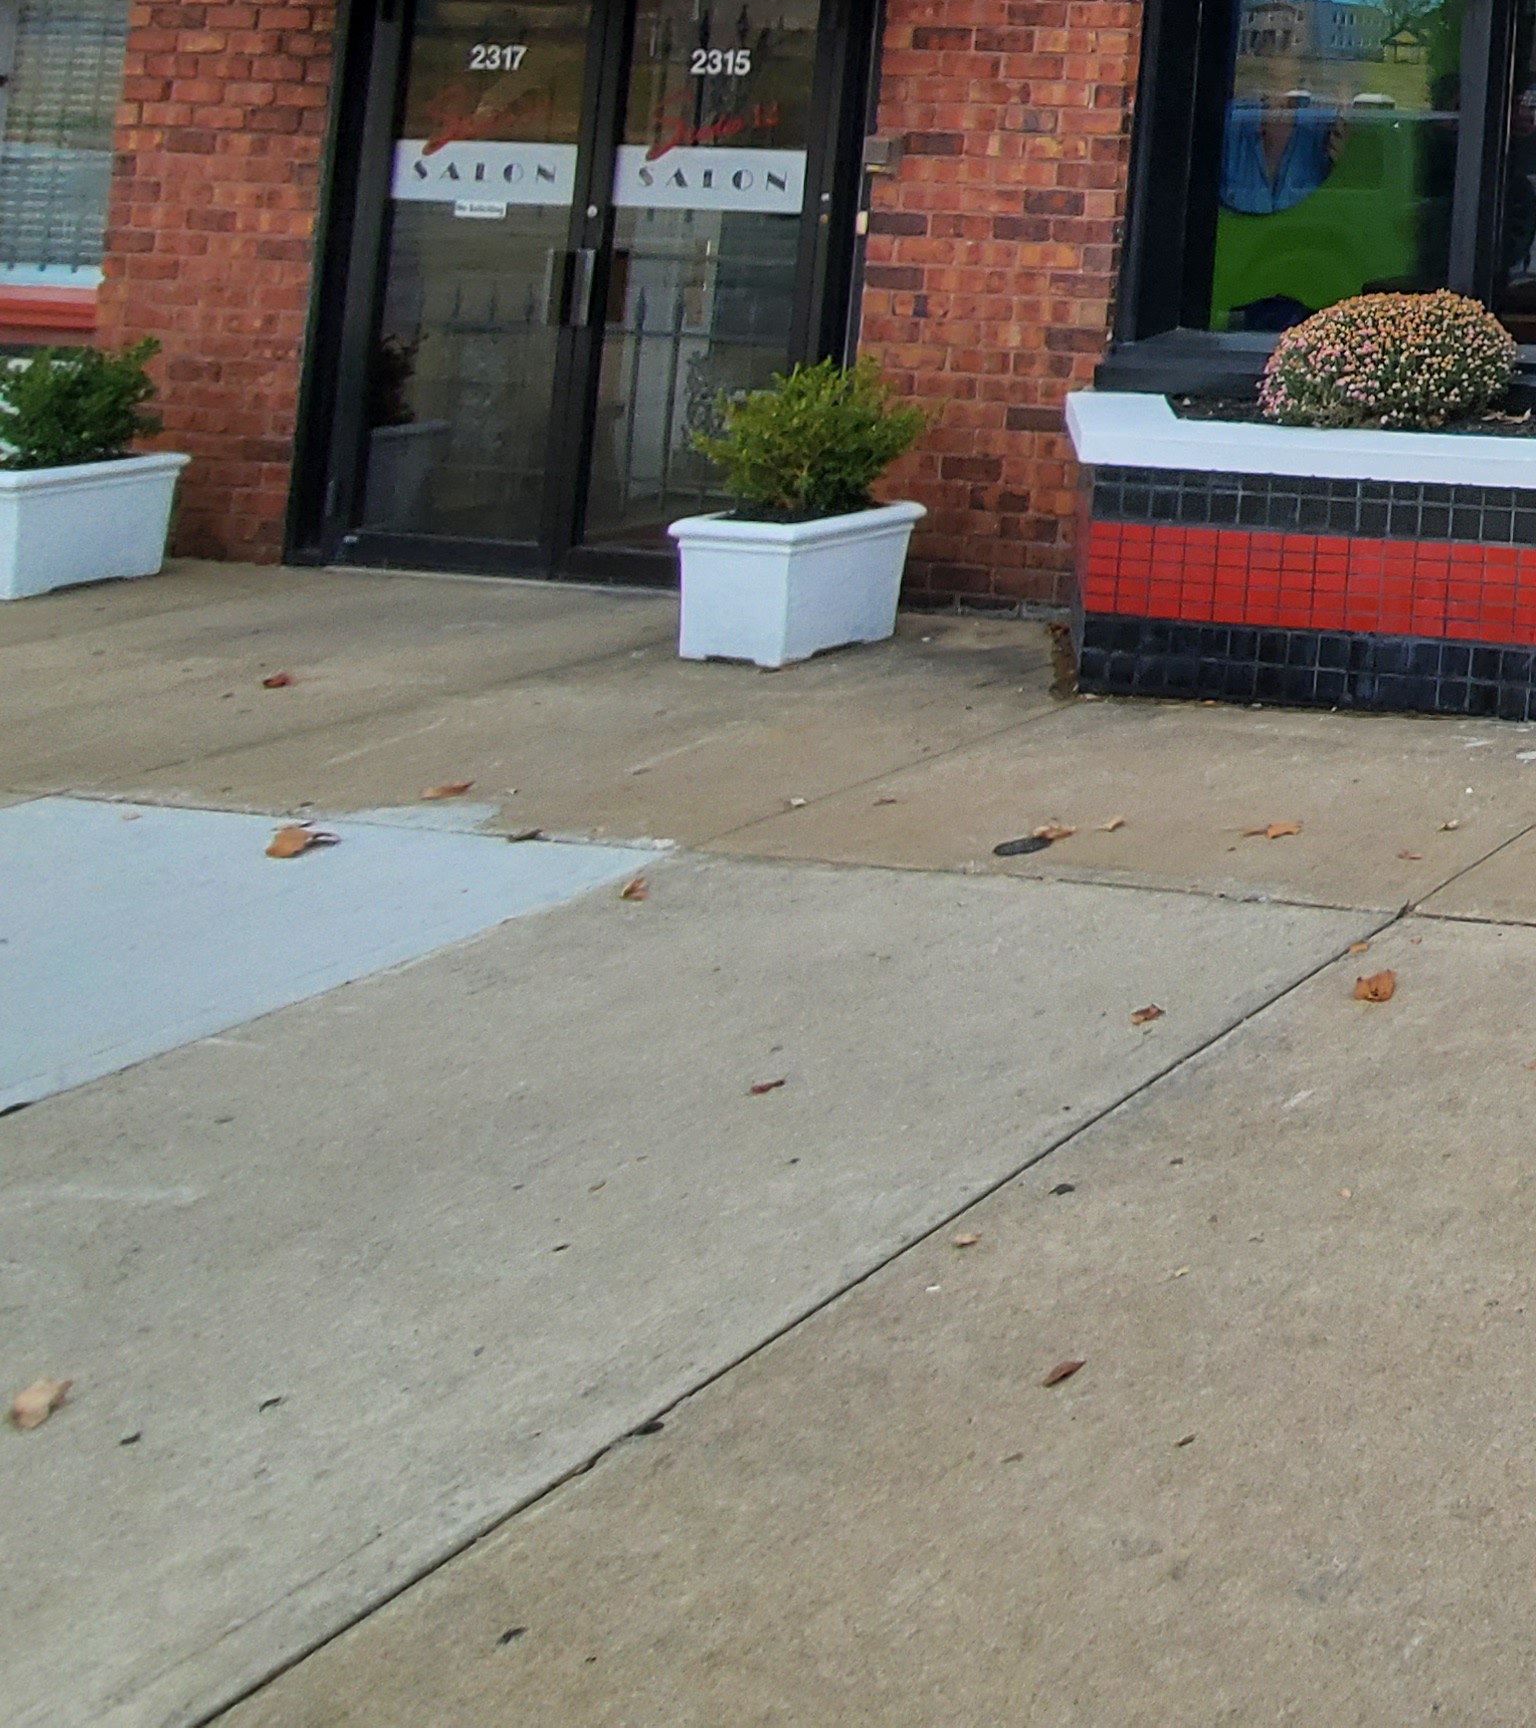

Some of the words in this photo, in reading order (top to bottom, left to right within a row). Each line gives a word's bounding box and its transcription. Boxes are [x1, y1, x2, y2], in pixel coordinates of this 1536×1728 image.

[469, 44, 528, 71] 2317
[690, 48, 751, 75] 2315
[413, 160, 557, 185] SALON
[638, 166, 788, 193] SALON
